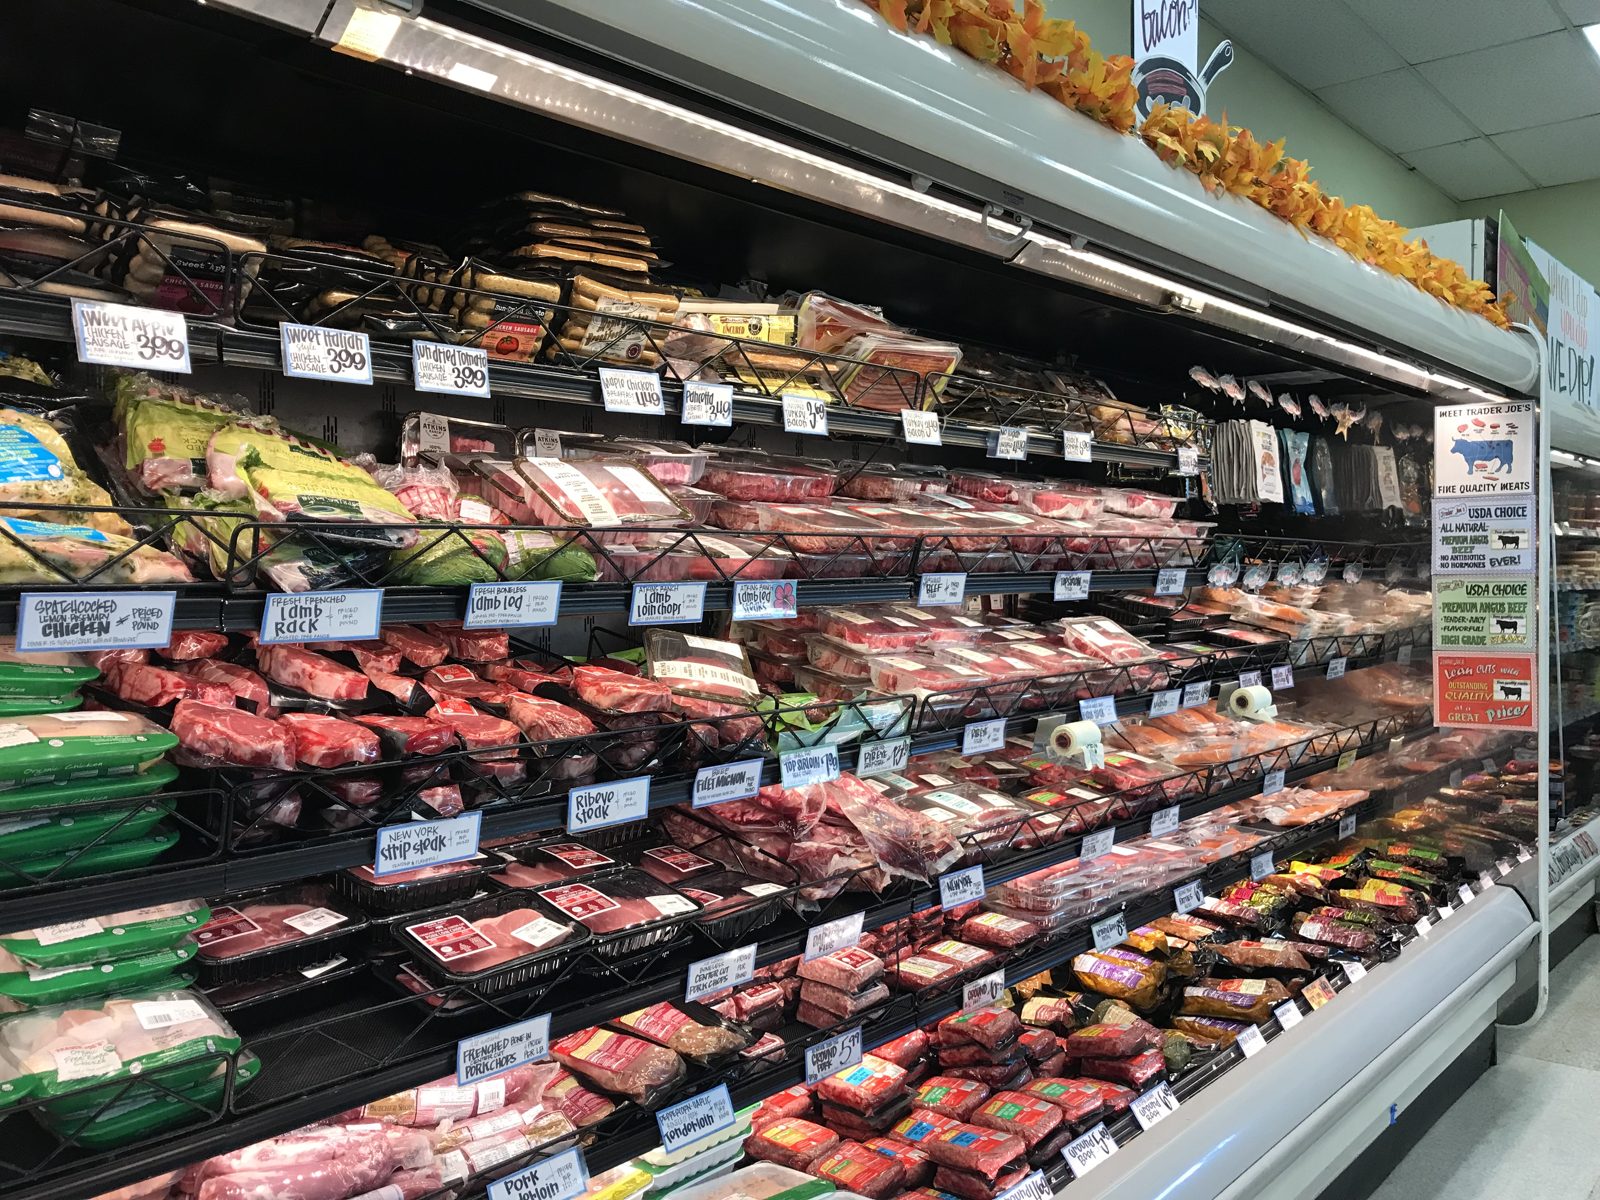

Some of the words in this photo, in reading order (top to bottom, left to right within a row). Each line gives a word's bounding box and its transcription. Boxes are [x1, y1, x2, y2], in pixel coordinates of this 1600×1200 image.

[87, 327, 125, 340] CHICKEN
[84, 337, 130, 349] SAUSAGE
[136, 334, 185, 360] 3.99
[327, 348, 366, 373] 3.99
[452, 367, 486, 388] 3.99
[1440, 409, 1462, 417] MEET
[1466, 407, 1502, 416] TRADER
[1505, 404, 1531, 413] JOE'S
[423, 423, 447, 431] ATKINS
[1438, 485, 1456, 494] FINE
[1459, 483, 1497, 494] QUALITY
[1501, 482, 1530, 491] MEATS
[1468, 508, 1492, 519] USDA
[1494, 506, 1527, 517] CHOICE
[1489, 555, 1521, 567] EVER!
[475, 587, 495, 596] FRESH
[497, 586, 527, 595] BONELESS
[1466, 584, 1489, 596] USDA
[1492, 584, 1527, 596] CHOICE
[35, 599, 117, 615] SPATCHCOCKED
[272, 598, 301, 607] FRESH
[305, 595, 346, 604] FRENCHED
[1442, 602, 1478, 613] PREMIUM
[1479, 602, 1506, 613] ANGUS
[1507, 602, 1527, 613] BEEF
[131, 621, 159, 631] POUND
[1441, 635, 1459, 645] HIGH
[1461, 635, 1486, 645] GRADE
[1444, 667, 1472, 679] Lean
[1476, 664, 1496, 674] CUTS
[1449, 681, 1488, 690] OUTSTANDING
[1445, 692, 1493, 700] QUALITY
[1448, 713, 1479, 721] GREAT
[1485, 705, 1529, 722] Price!
[576, 791, 614, 810] Ribeye
[389, 830, 412, 842] NEW
[414, 826, 439, 838] YORK
[464, 1038, 509, 1063] FRENCHED
[811, 1045, 837, 1066] GROUND
[465, 1060, 489, 1079] PORK
[489, 1053, 516, 1070] CHOPS
[665, 1113, 714, 1143] Tenderloin
[1068, 1135, 1094, 1158] Ground
[1077, 1149, 1094, 1167] Beef
[504, 1169, 540, 1195] Pork
